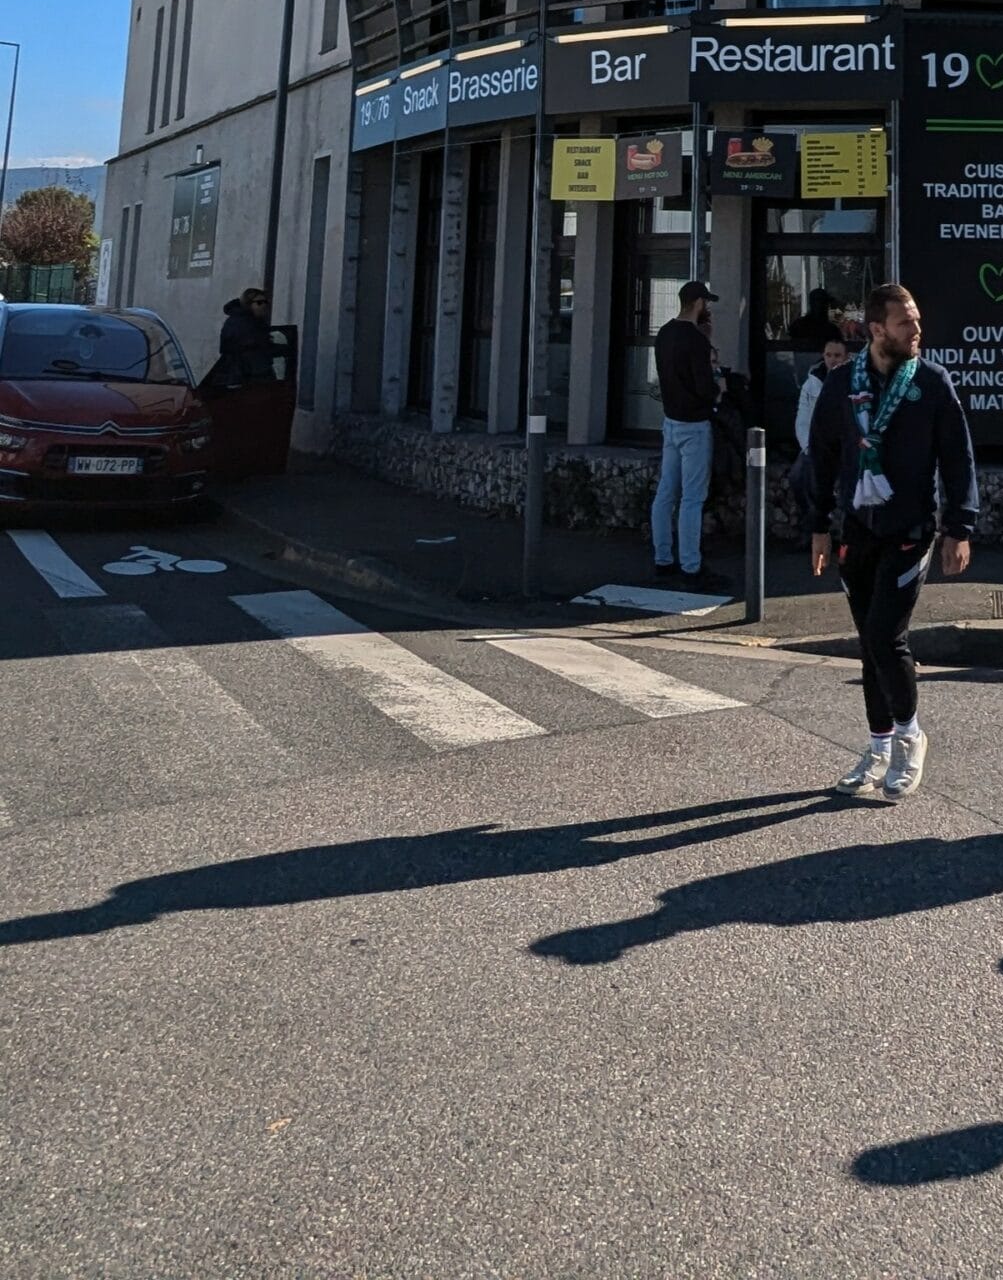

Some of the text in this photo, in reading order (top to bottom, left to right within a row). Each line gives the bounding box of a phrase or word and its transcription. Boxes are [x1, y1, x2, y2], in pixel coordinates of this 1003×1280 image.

[590, 50, 647, 85] Bar
[689, 35, 896, 73] Restaurant
[403, 77, 439, 115] Snack
[449, 59, 538, 103] Brasserie
[920, 348, 963, 365] UNDI
[968, 349, 996, 365] AU
